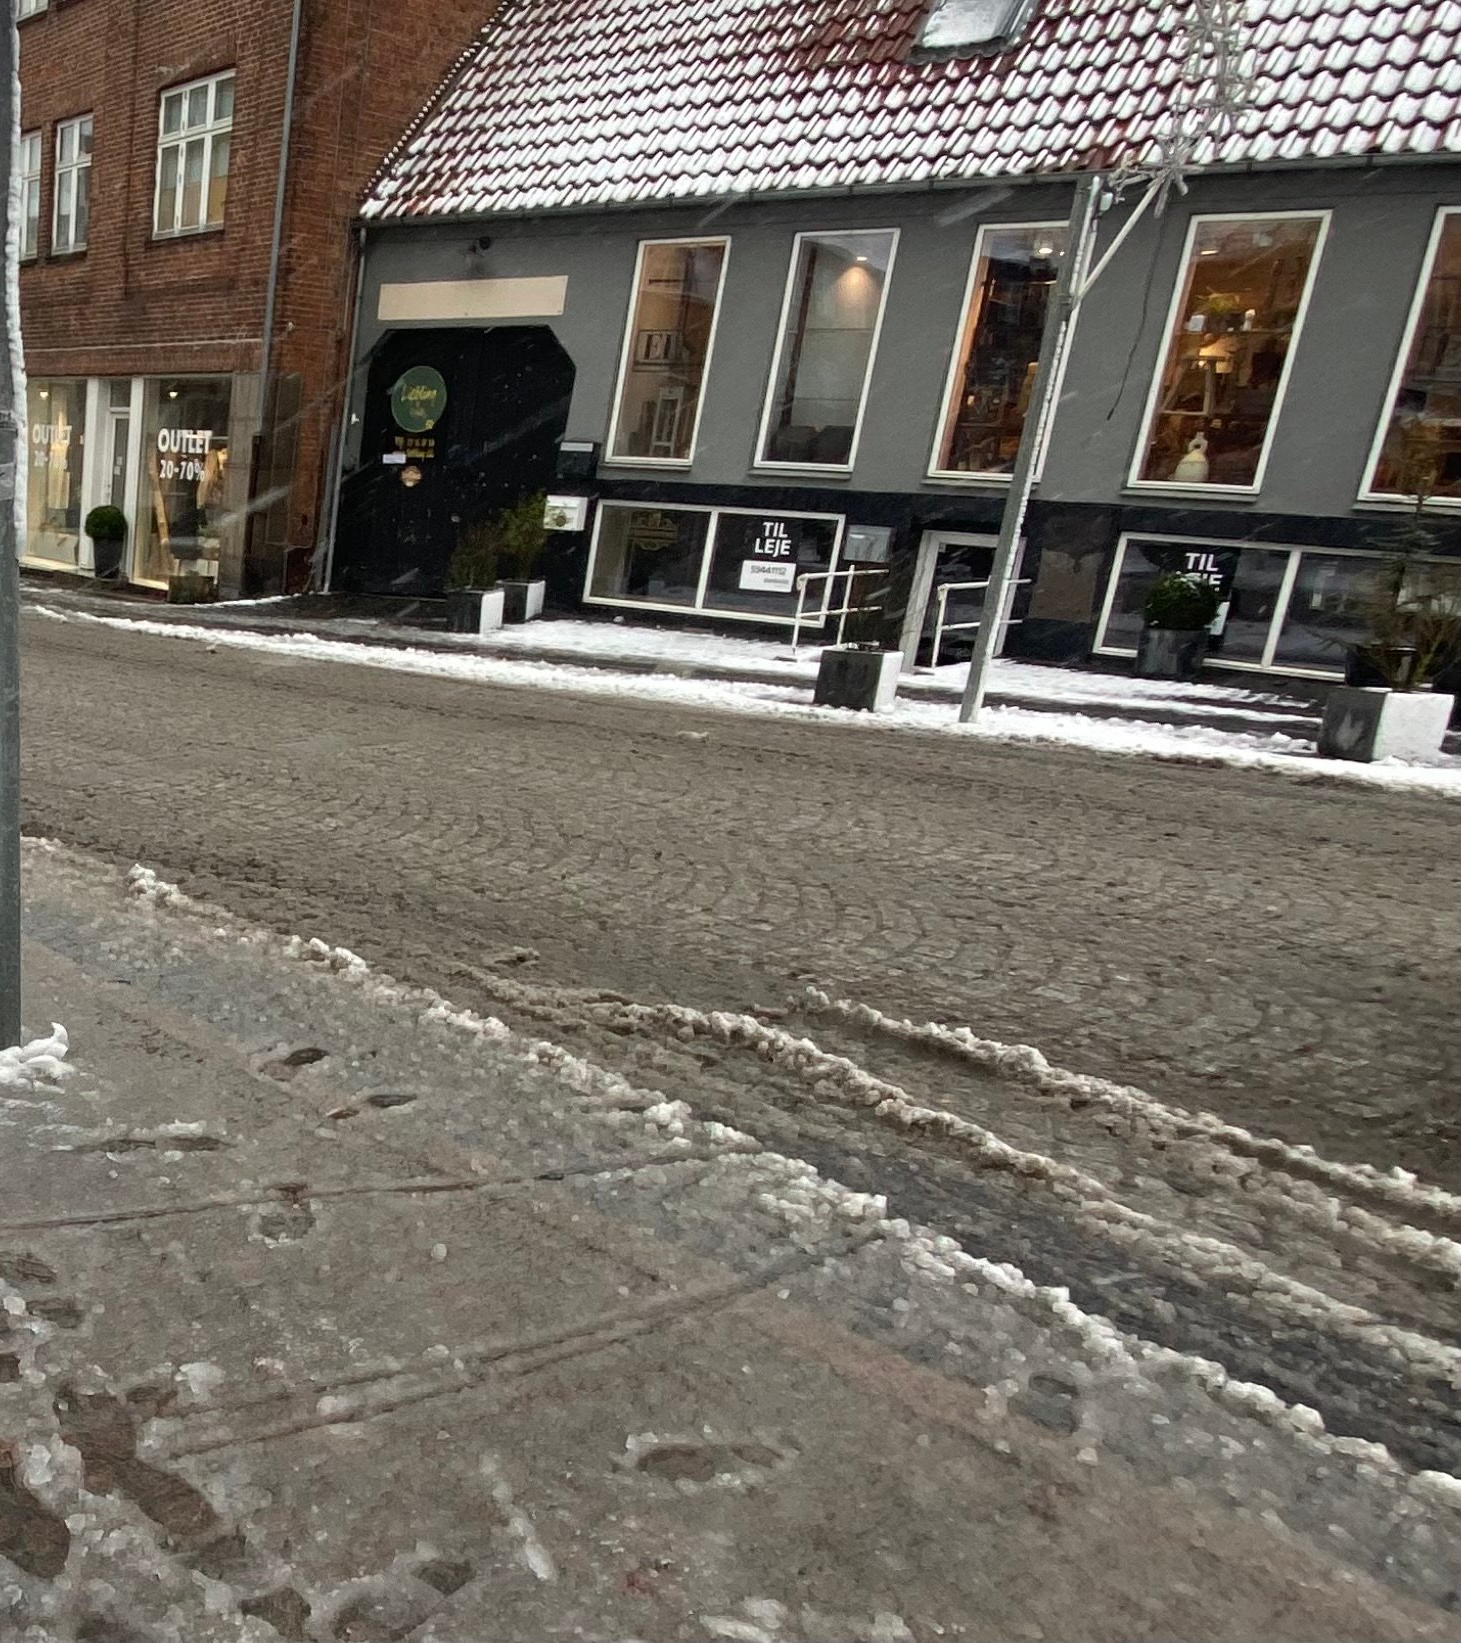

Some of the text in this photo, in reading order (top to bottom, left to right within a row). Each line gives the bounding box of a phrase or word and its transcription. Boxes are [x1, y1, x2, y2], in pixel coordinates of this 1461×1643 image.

[157, 428, 212, 454] OUTLET
[159, 459, 205, 481] 20-70%
[762, 522, 788, 538] TIL
[754, 538, 791, 557] LEJE
[1185, 552, 1219, 571] TIL
